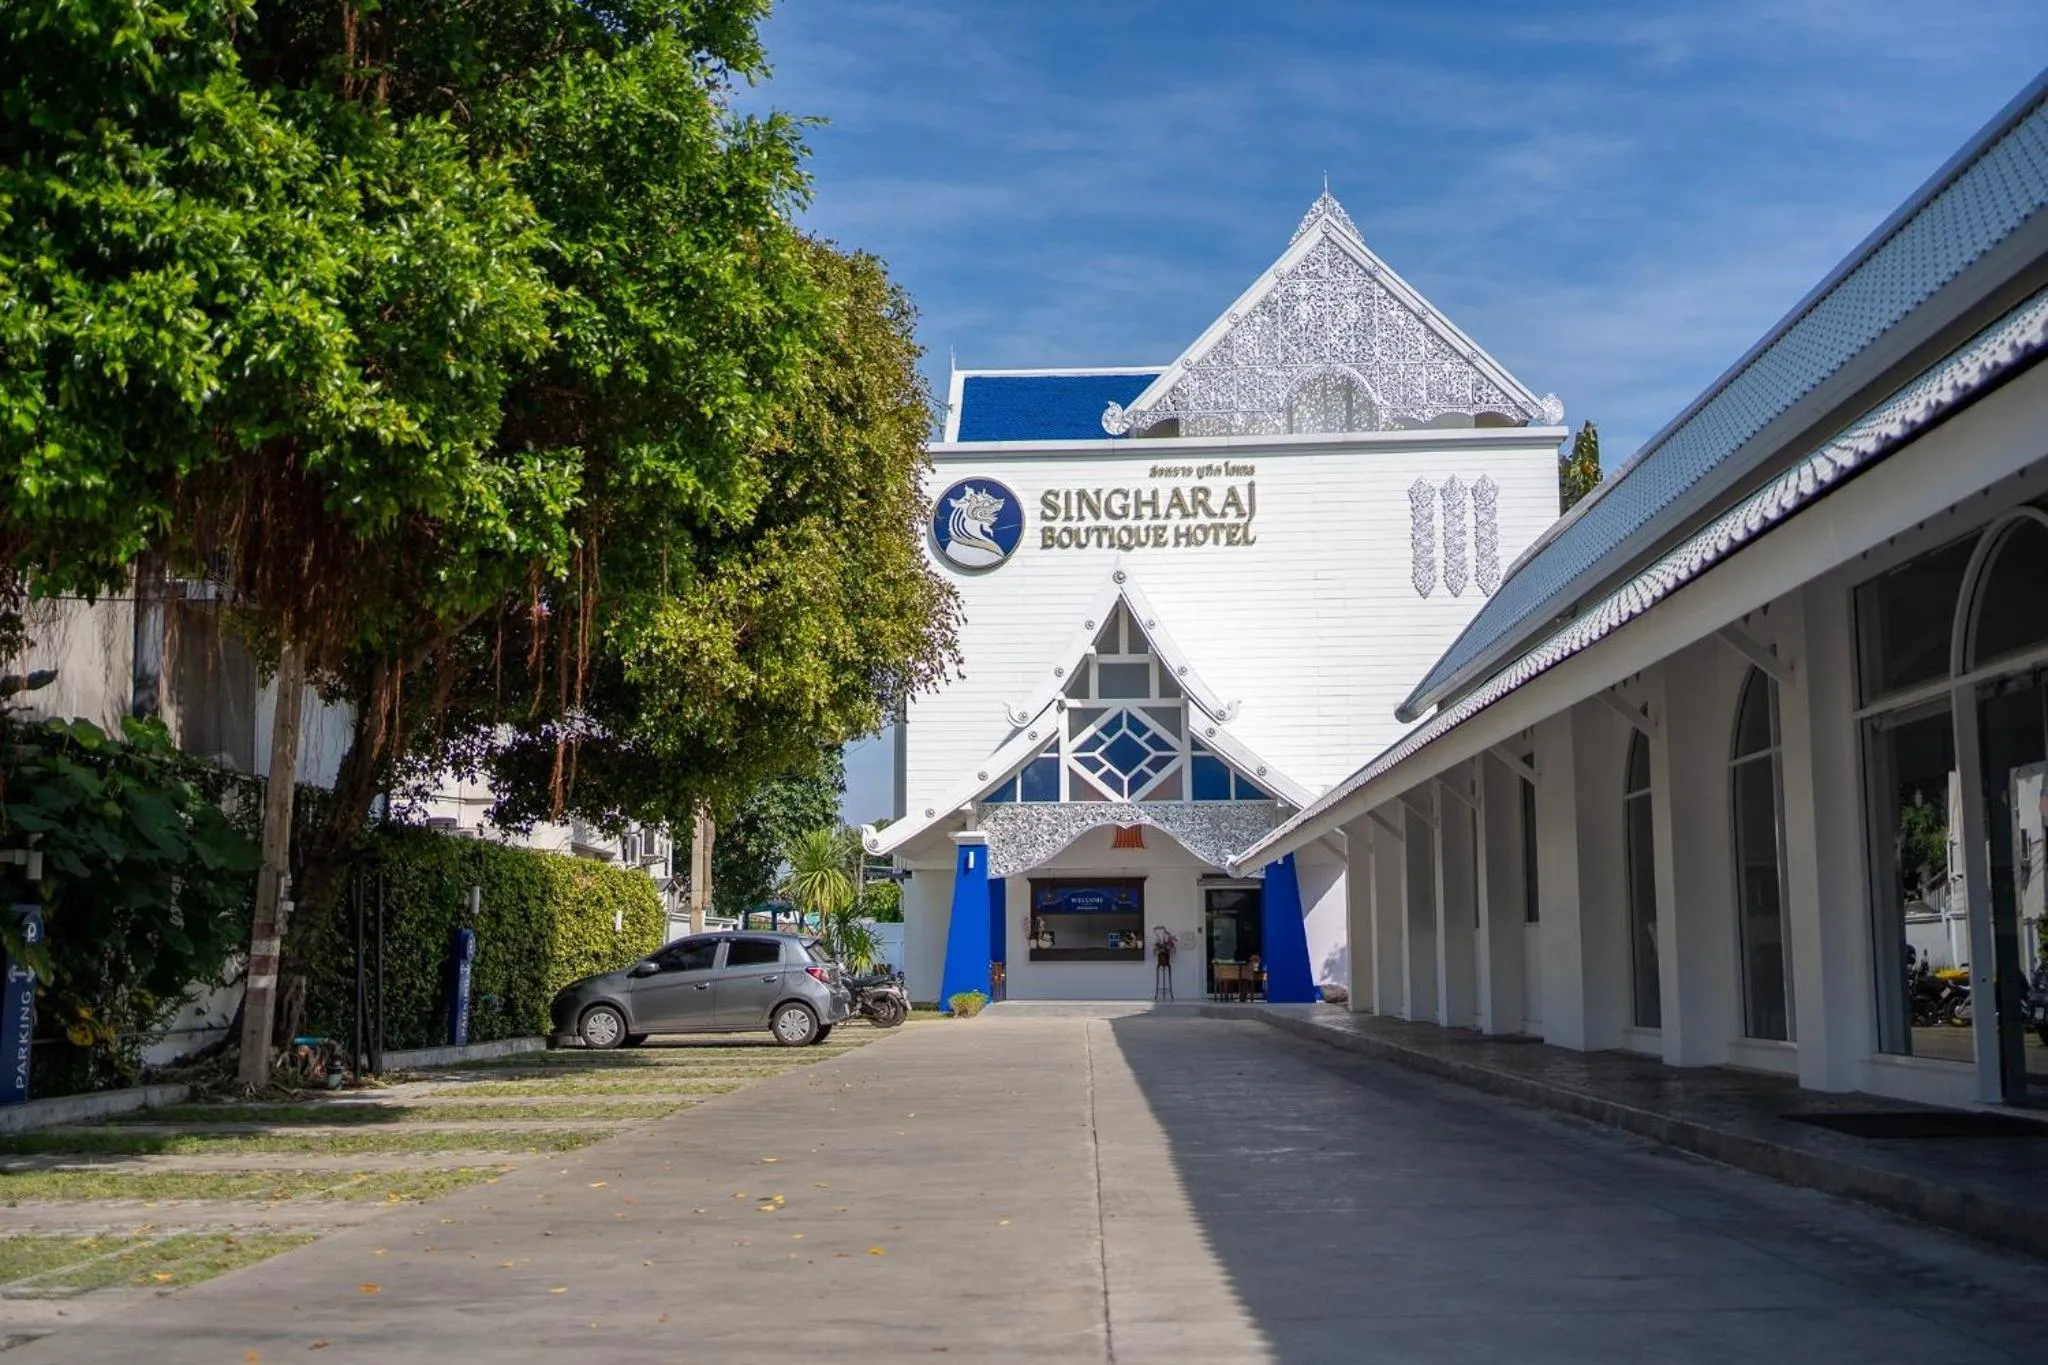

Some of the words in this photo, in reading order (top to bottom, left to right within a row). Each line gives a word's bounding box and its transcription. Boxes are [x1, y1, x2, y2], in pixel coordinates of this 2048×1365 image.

[1040, 480, 1256, 522] SINGHARAJ
[1040, 525, 1168, 551] BOUTIQUE
[1172, 522, 1257, 548] HOTEL
[16, 990, 32, 1089] PARKING
